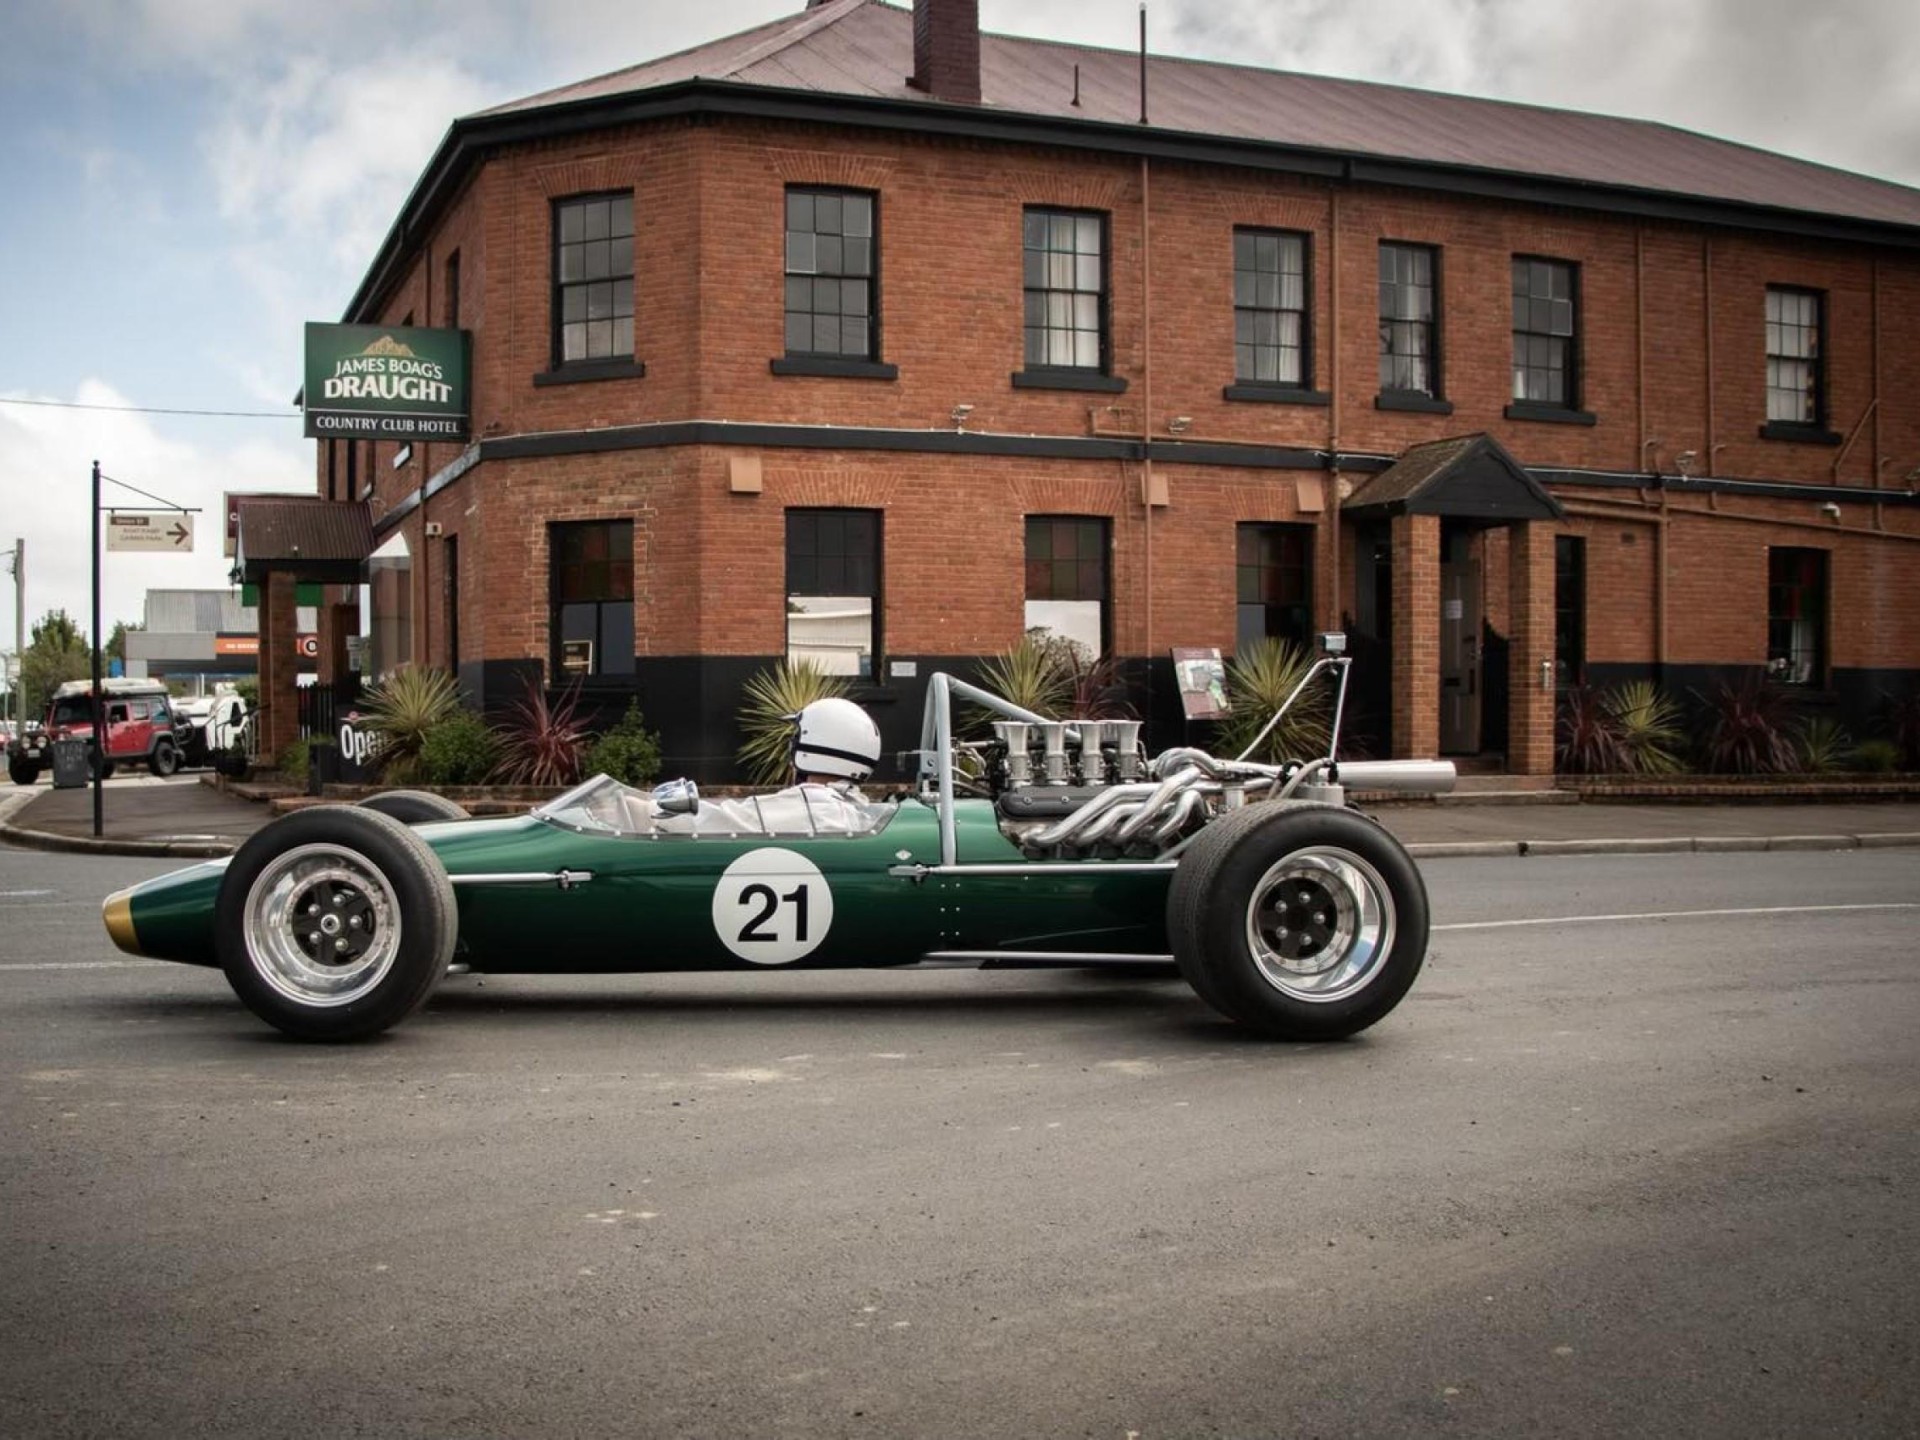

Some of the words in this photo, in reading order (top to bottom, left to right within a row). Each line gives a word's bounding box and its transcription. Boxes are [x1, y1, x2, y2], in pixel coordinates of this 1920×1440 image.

[335, 358, 385, 377] JAMES
[389, 359, 443, 380] BOAG'S
[324, 374, 453, 403] DRAUGHT
[316, 416, 379, 430] COUNTRY
[382, 418, 415, 431] CLUB
[418, 420, 460, 433] HOTEL
[737, 883, 808, 942] 21
